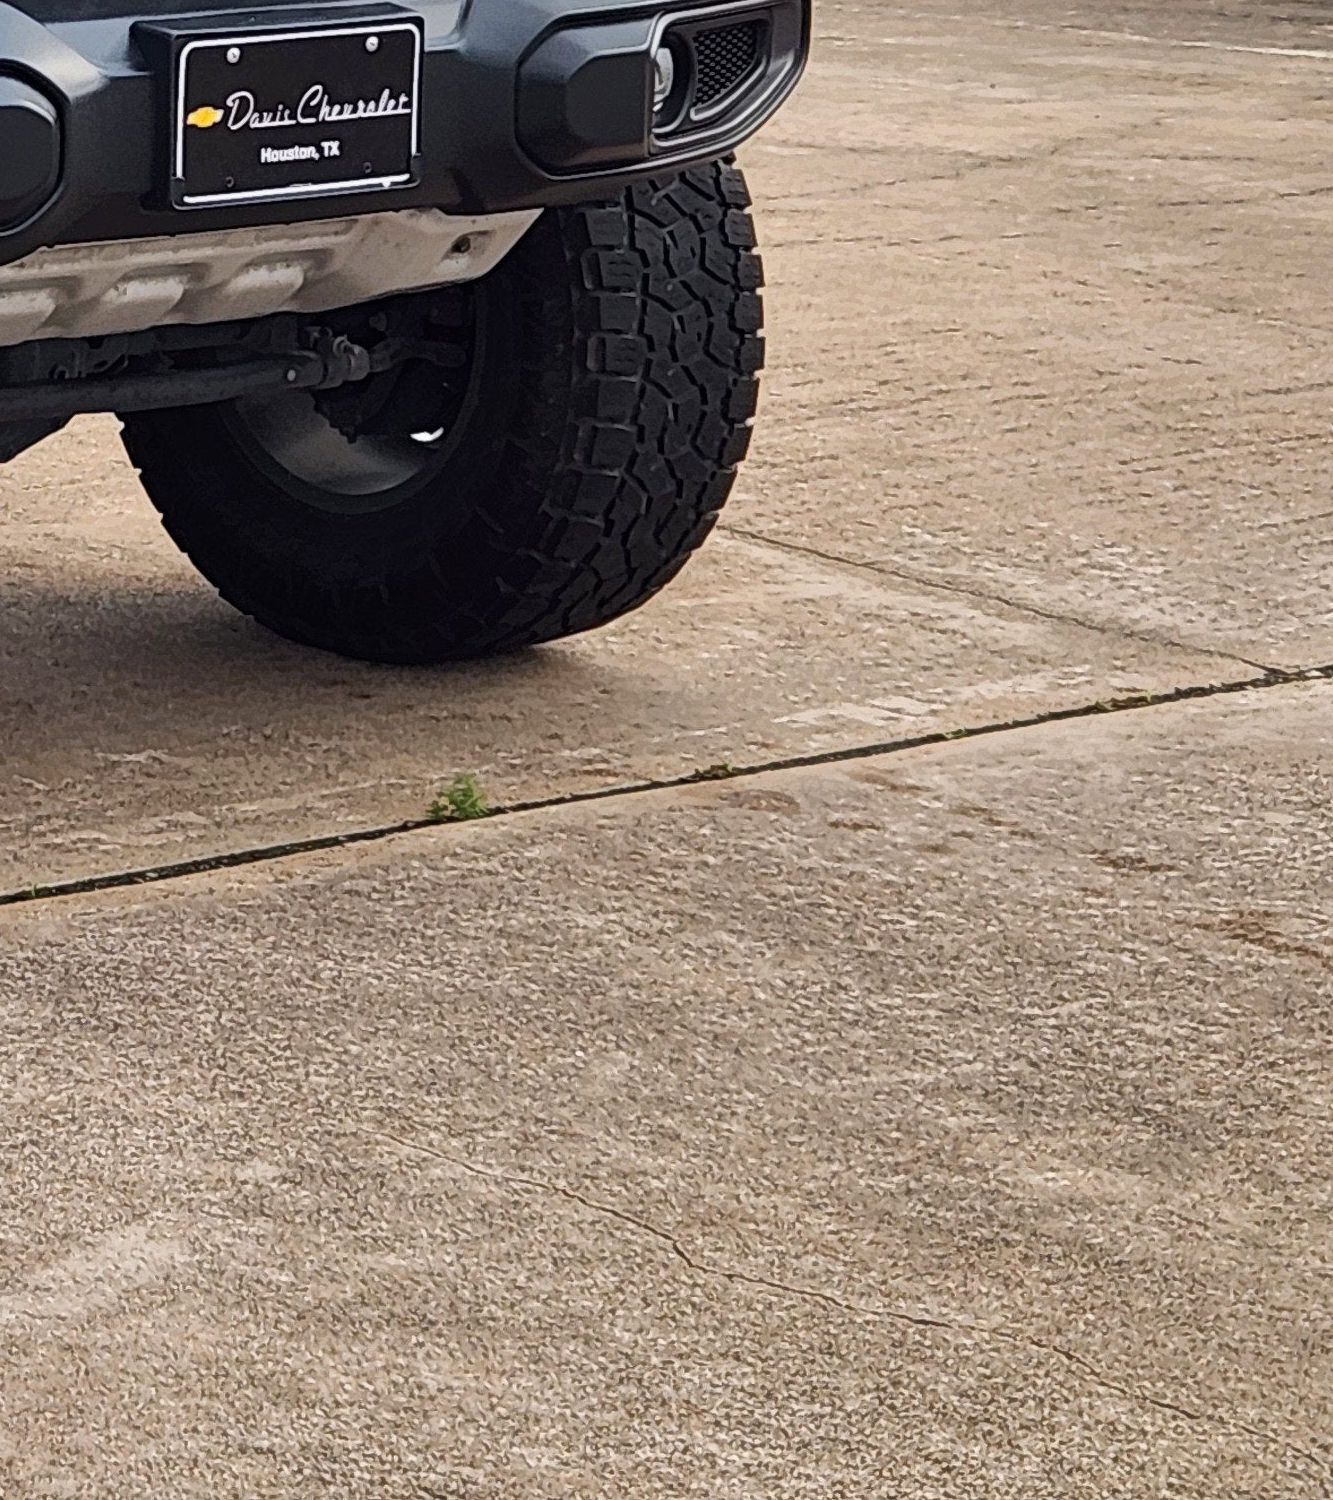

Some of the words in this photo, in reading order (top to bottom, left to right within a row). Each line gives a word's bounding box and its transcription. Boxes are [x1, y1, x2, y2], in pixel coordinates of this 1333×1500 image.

[225, 90, 296, 131] Davis
[260, 146, 320, 164] Houston,
[320, 140, 341, 157] TX
